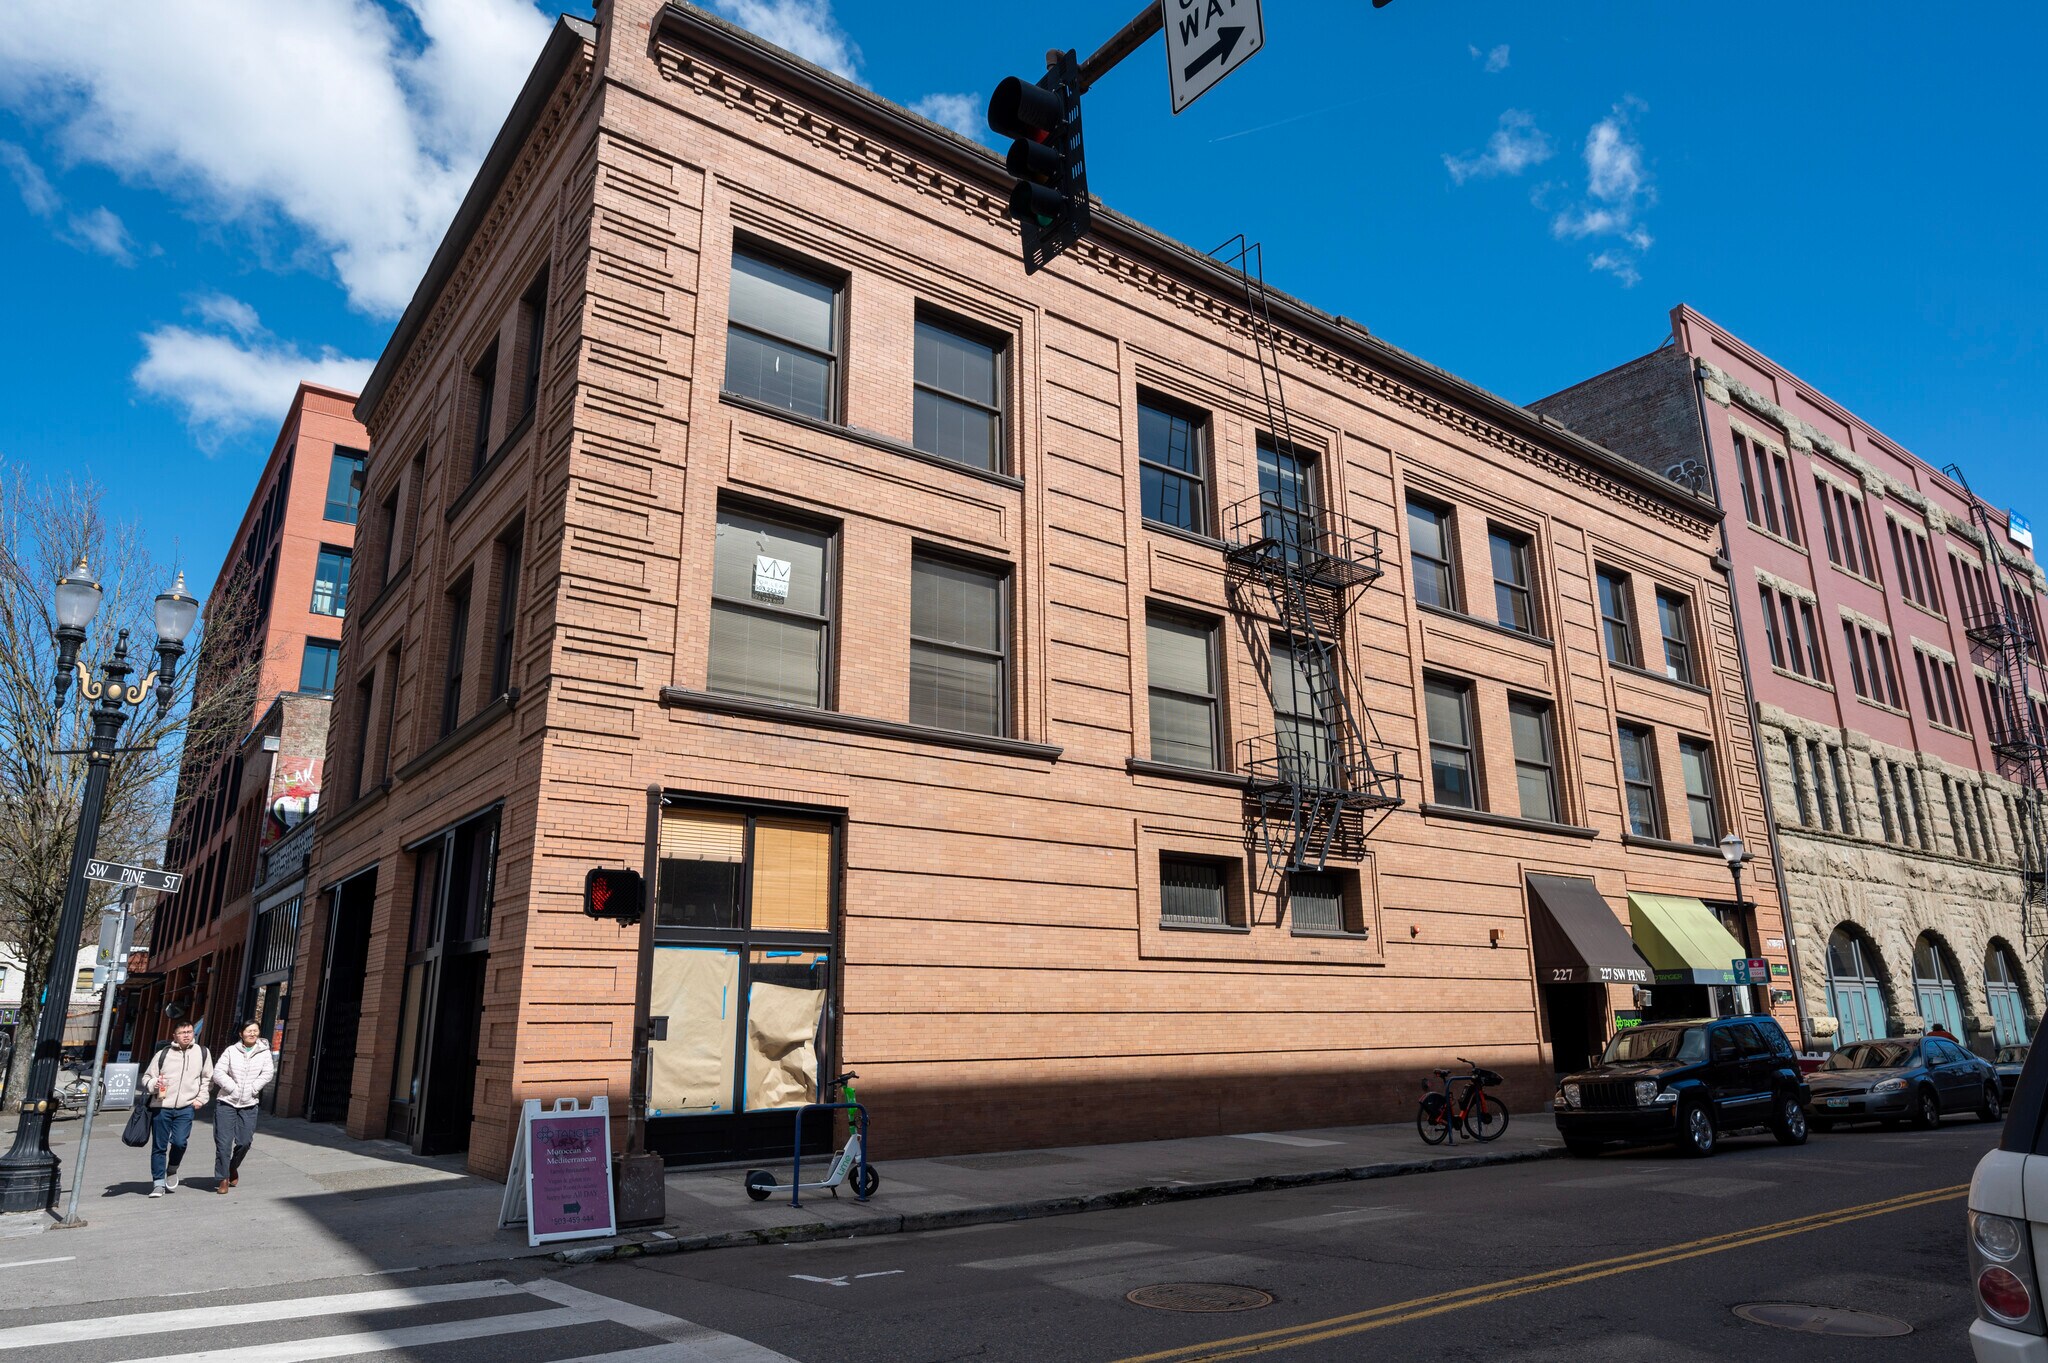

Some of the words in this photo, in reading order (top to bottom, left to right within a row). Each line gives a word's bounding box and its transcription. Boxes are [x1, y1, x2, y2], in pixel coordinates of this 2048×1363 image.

[1179, 0, 1236, 47] WA
[88, 862, 109, 878] SW
[120, 868, 147, 884] PINE
[162, 875, 178, 889] ST
[1552, 968, 1573, 981] 227
[1599, 967, 1612, 980] 227
[1613, 967, 1626, 981] SW
[1627, 968, 1647, 982] PINE
[1739, 971, 1746, 980] 2
[555, 1127, 600, 1138] TANGIER
[546, 1148, 582, 1156] Moroccan
[546, 1156, 597, 1165] Mediterranean
[583, 1189, 598, 1198] DAY
